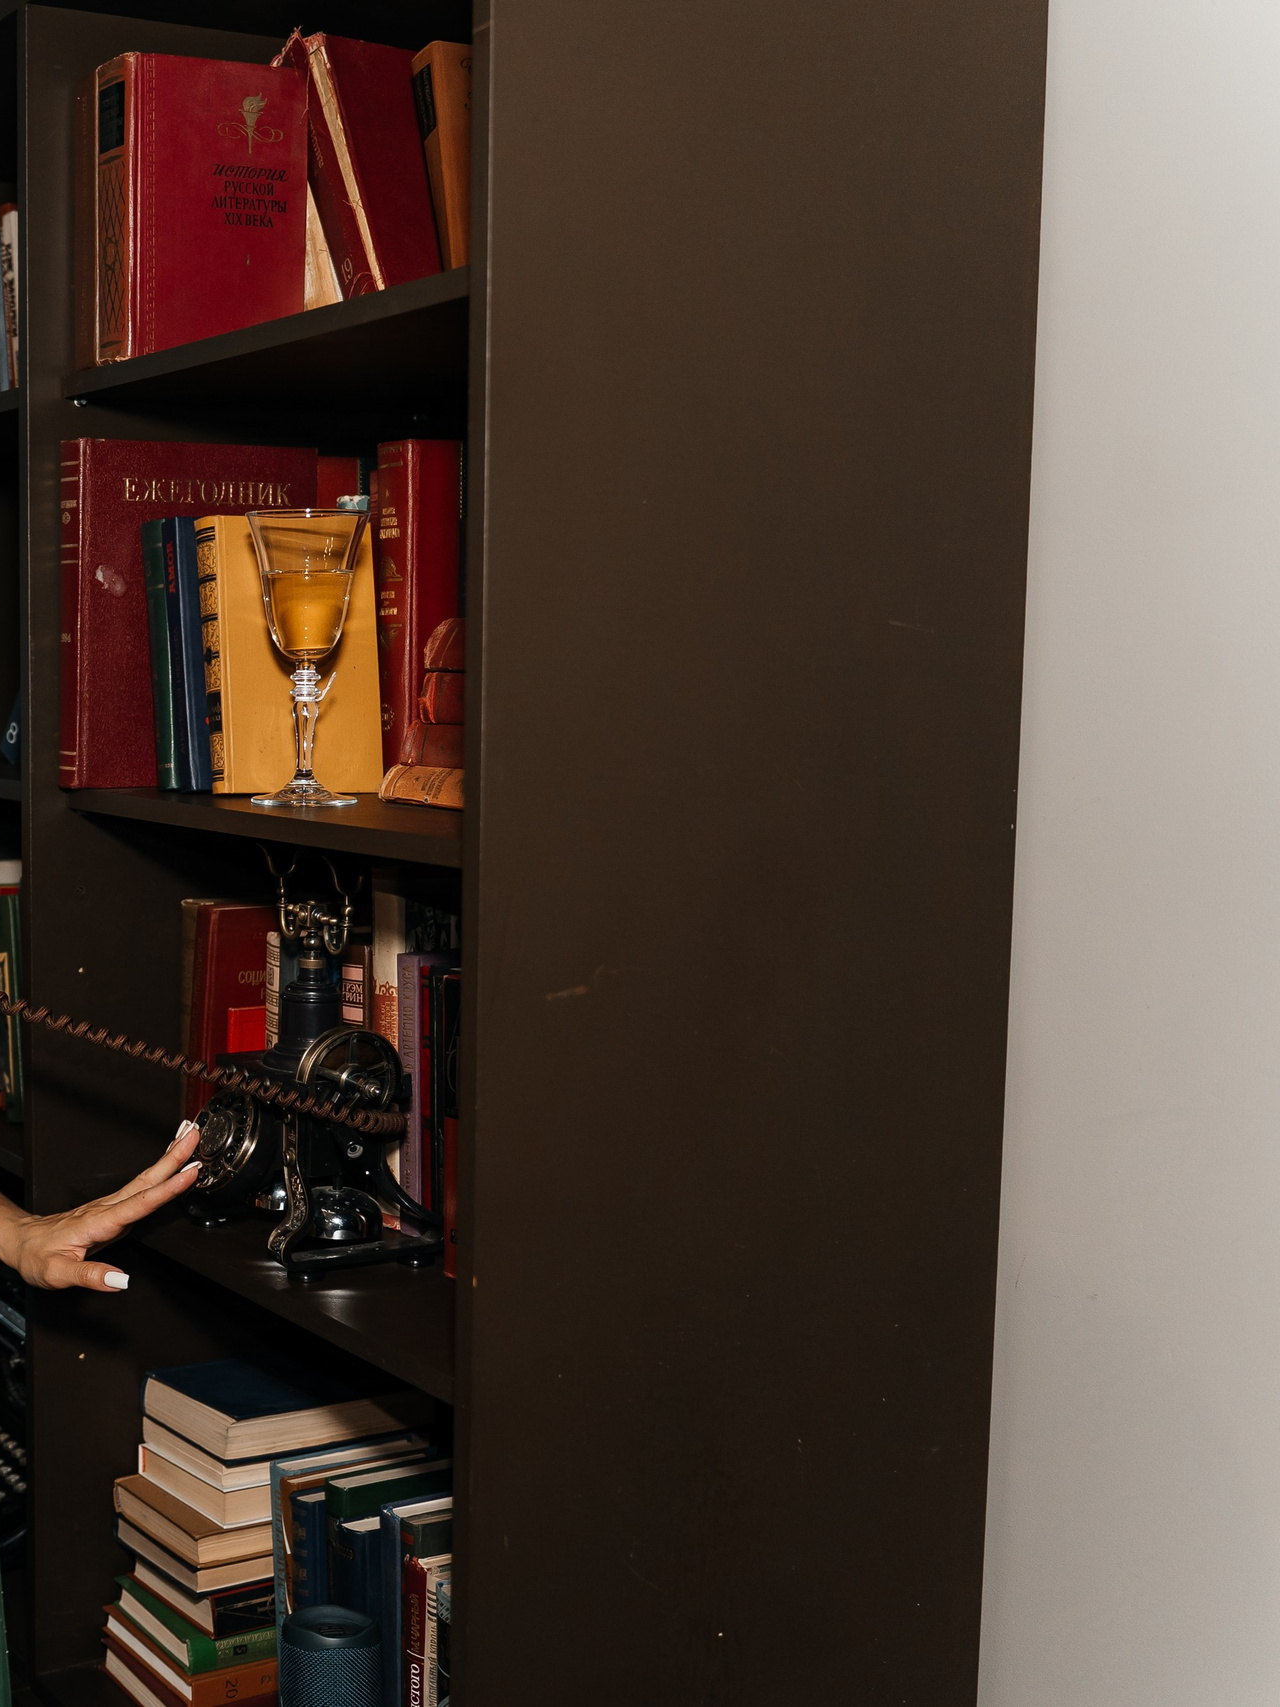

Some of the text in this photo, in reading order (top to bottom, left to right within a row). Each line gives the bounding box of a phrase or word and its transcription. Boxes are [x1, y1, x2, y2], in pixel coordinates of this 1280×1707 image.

[224, 180, 274, 196] РУССКОЙ
[211, 195, 288, 214] ЛИТЕРАТУРЫ
[224, 212, 274, 228] XIX ВЕКА
[340, 257, 354, 286] 19
[122, 476, 292, 507] ЕЖЕГОДНИК
[165, 540, 176, 594] AMOR
[6, 721, 19, 744] 8
[342, 982, 363, 994] ГРЭМ
[402, 966, 414, 1001] КРУСА
[342, 991, 363, 1003] ГРИН
[402, 1006, 414, 1059] АРТЕМИО
[225, 1678, 238, 1699] 20
